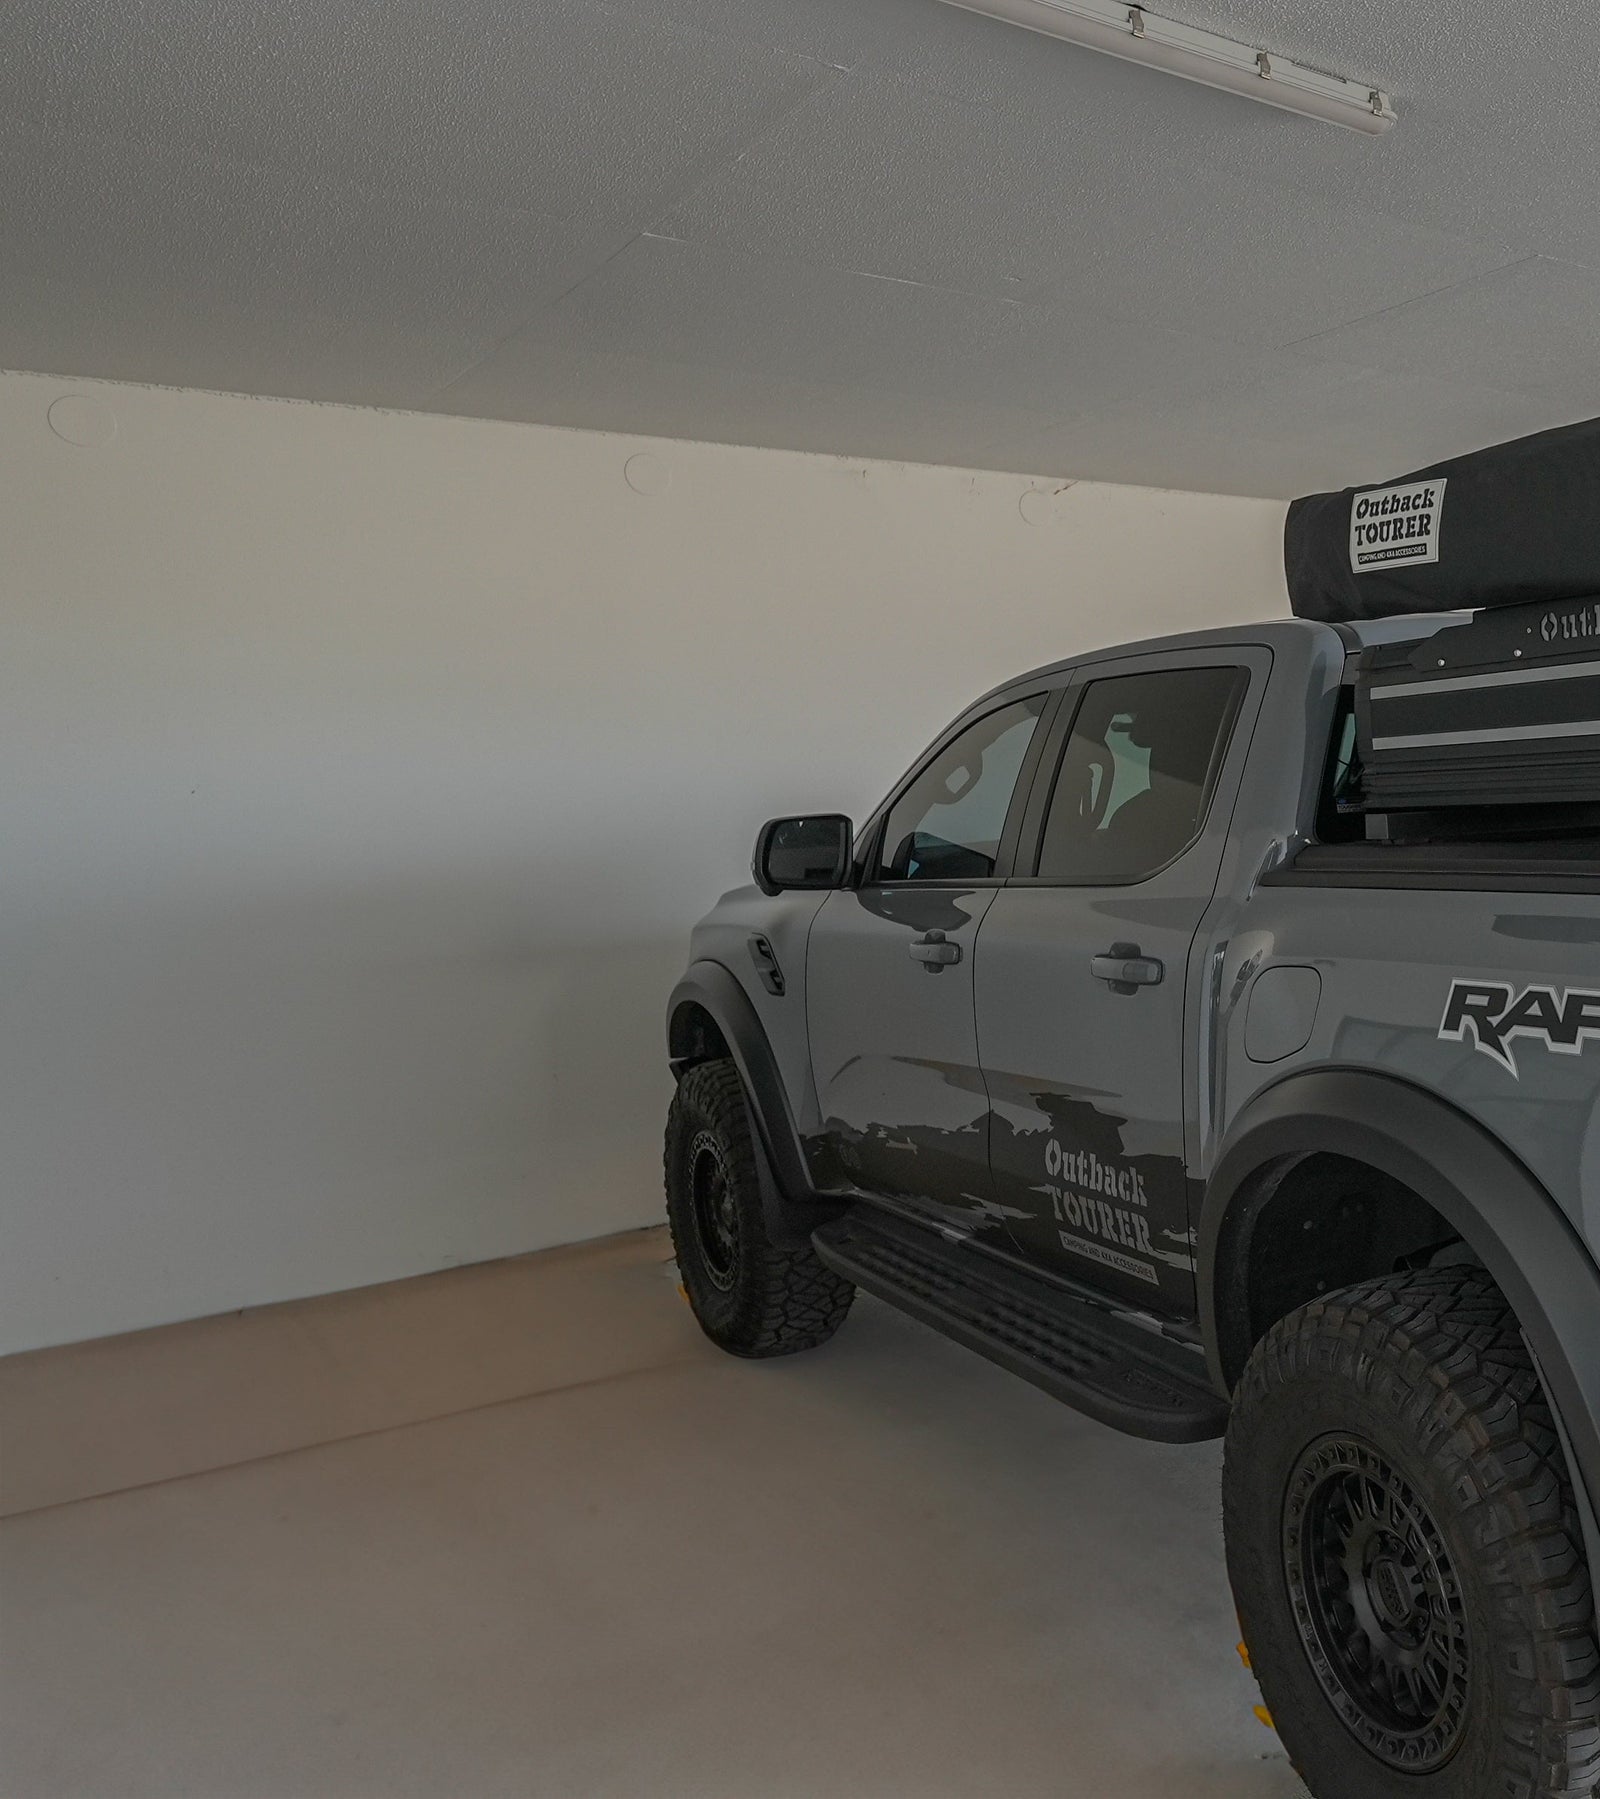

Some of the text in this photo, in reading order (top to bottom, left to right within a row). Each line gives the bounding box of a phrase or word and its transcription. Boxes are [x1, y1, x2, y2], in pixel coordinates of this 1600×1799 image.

[1356, 488, 1435, 519] Outback
[1355, 514, 1431, 546] TOURER
[1045, 1138, 1148, 1207] Outback
[1046, 1184, 1152, 1252] TOURER
